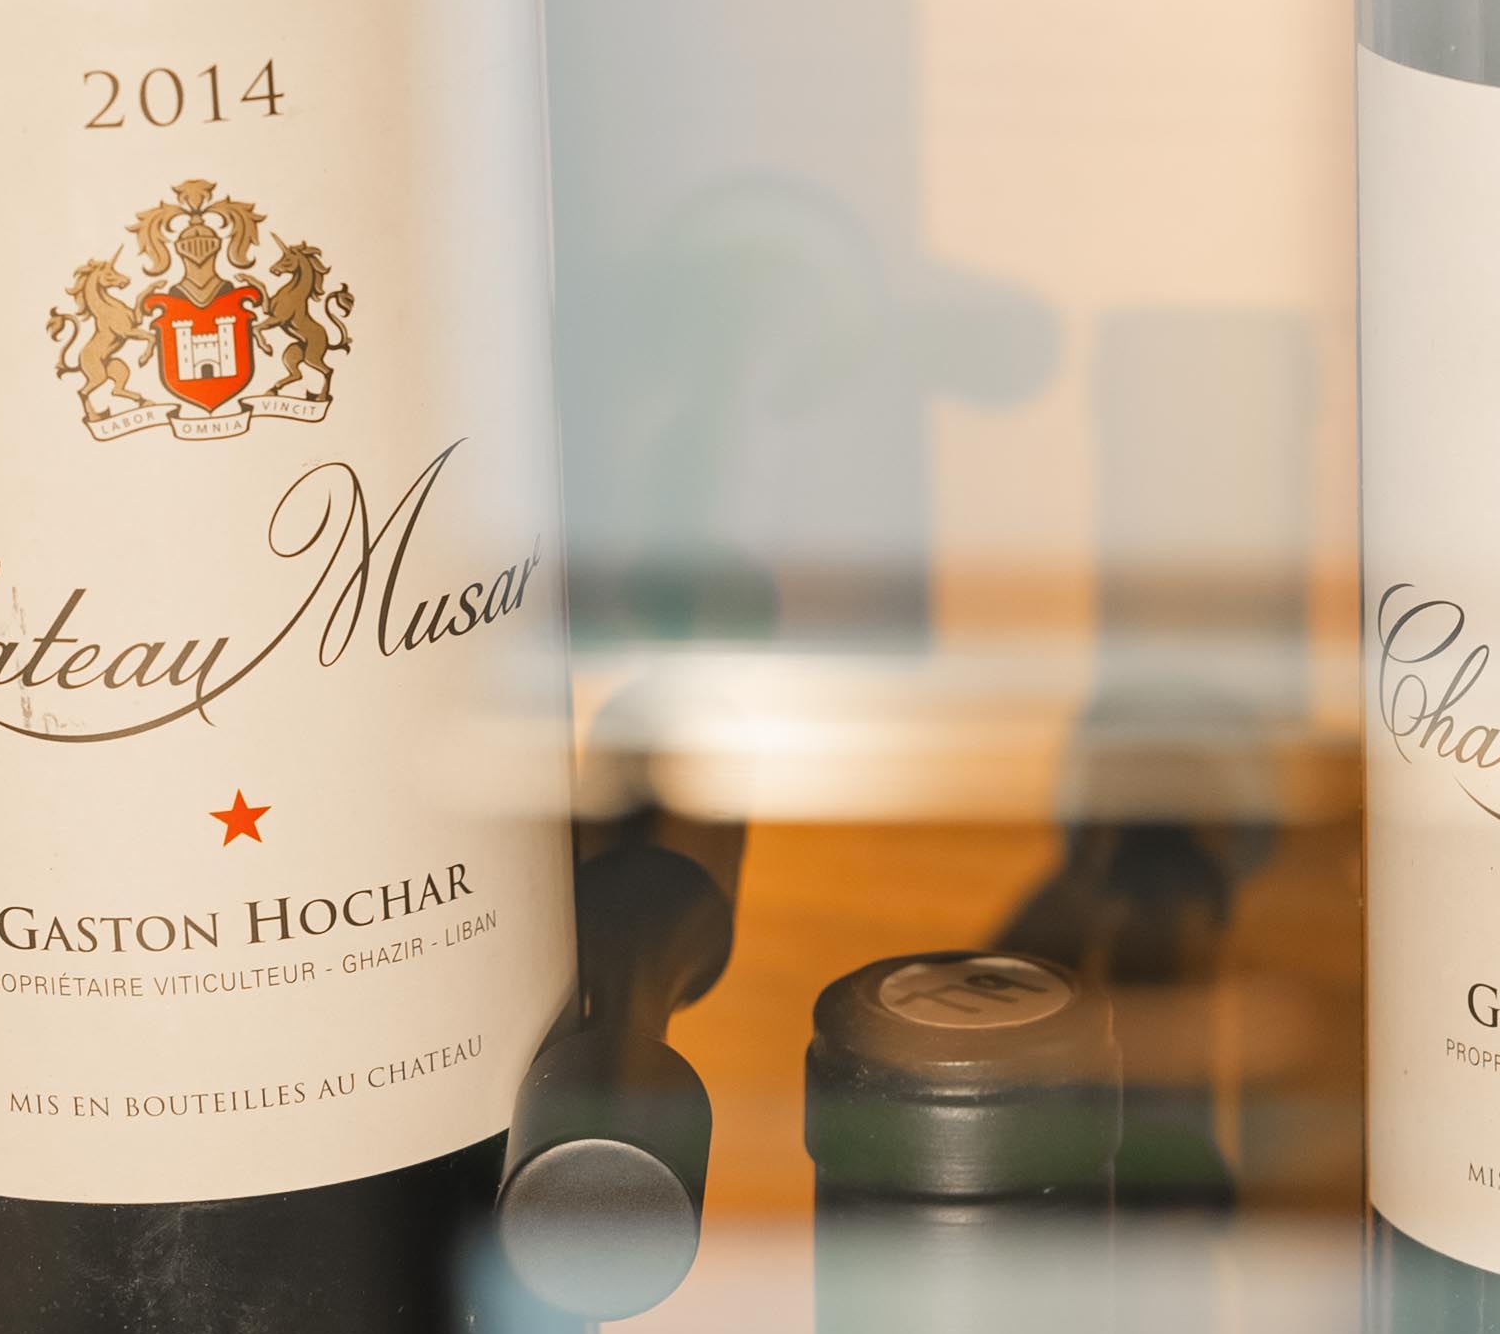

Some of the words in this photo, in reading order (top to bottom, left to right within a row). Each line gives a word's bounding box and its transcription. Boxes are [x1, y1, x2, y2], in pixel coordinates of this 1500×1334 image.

[82, 58, 286, 130] 2014
[101, 410, 155, 436] LABOR
[182, 419, 243, 436] OMNIA
[261, 400, 318, 418] VINCIT
[268, 437, 542, 668] Musar
[245, 861, 475, 946] HOCHAR
[154, 961, 317, 998] VITICULTEUR
[341, 939, 427, 979] GHAZIR
[443, 909, 499, 950] LIBAN
[9, 1090, 60, 1118] MIS
[72, 1094, 111, 1118] EN
[125, 1082, 307, 1119] BOUTEILLES
[317, 1072, 357, 1100] AU
[367, 1034, 485, 1089] CHATEAU
